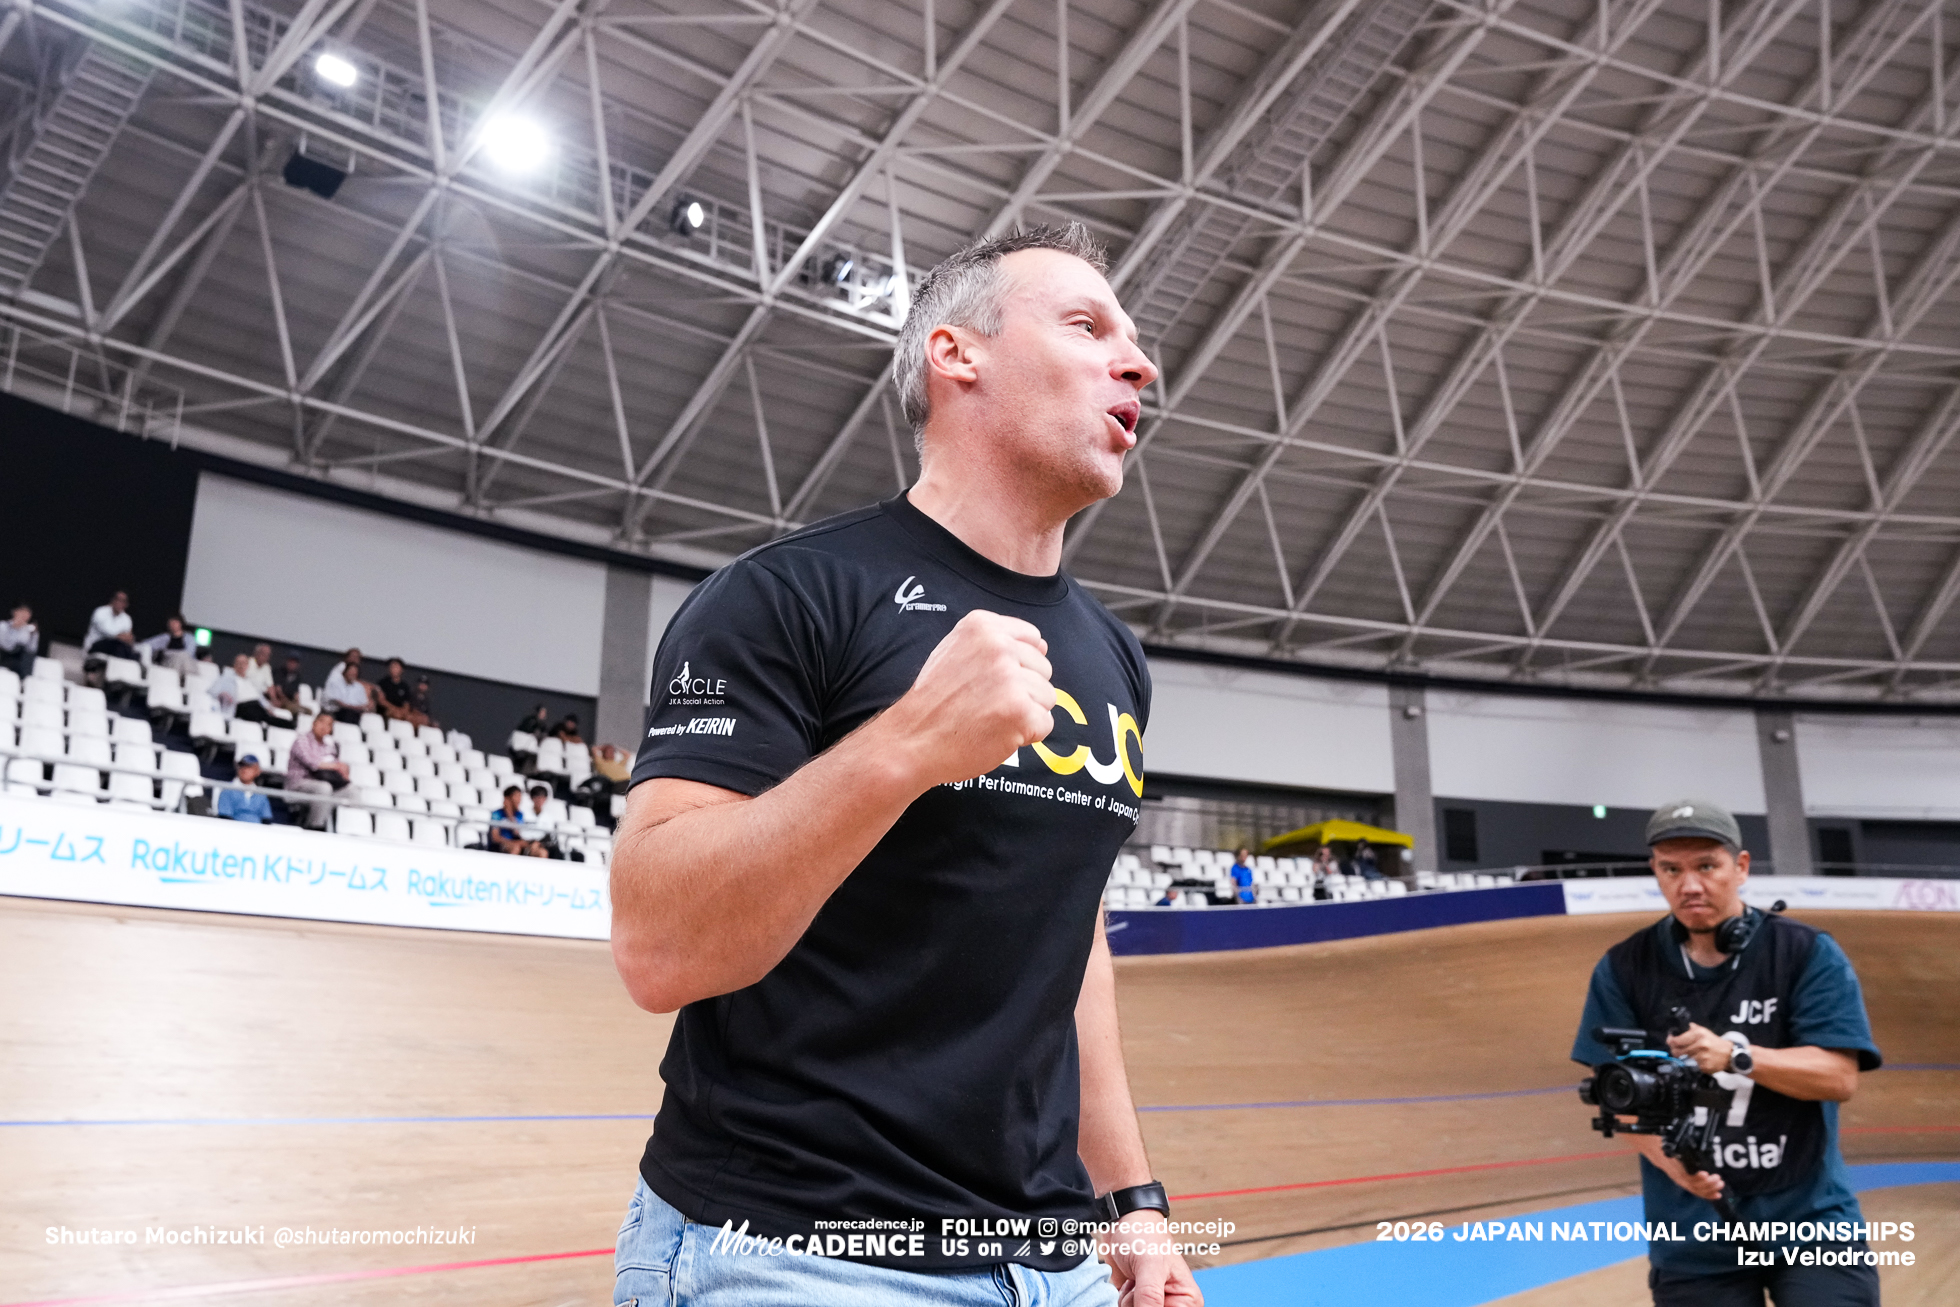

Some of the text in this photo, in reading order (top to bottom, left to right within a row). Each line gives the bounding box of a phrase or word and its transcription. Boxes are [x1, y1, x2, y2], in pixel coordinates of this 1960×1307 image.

[669, 678, 728, 695] CYCLE
[668, 698, 725, 706] JKA Social Action
[647, 717, 737, 738] Powered by KEIRIN
[1000, 687, 1144, 798] CJC
[978, 774, 1054, 800] Performance
[1056, 787, 1093, 807] Center
[1094, 795, 1107, 809] of
[1108, 797, 1134, 817] Japan
[131, 838, 389, 892] Rakuten Kドリームス
[407, 869, 501, 902] Rakuten
[1731, 998, 1778, 1025] JCF
